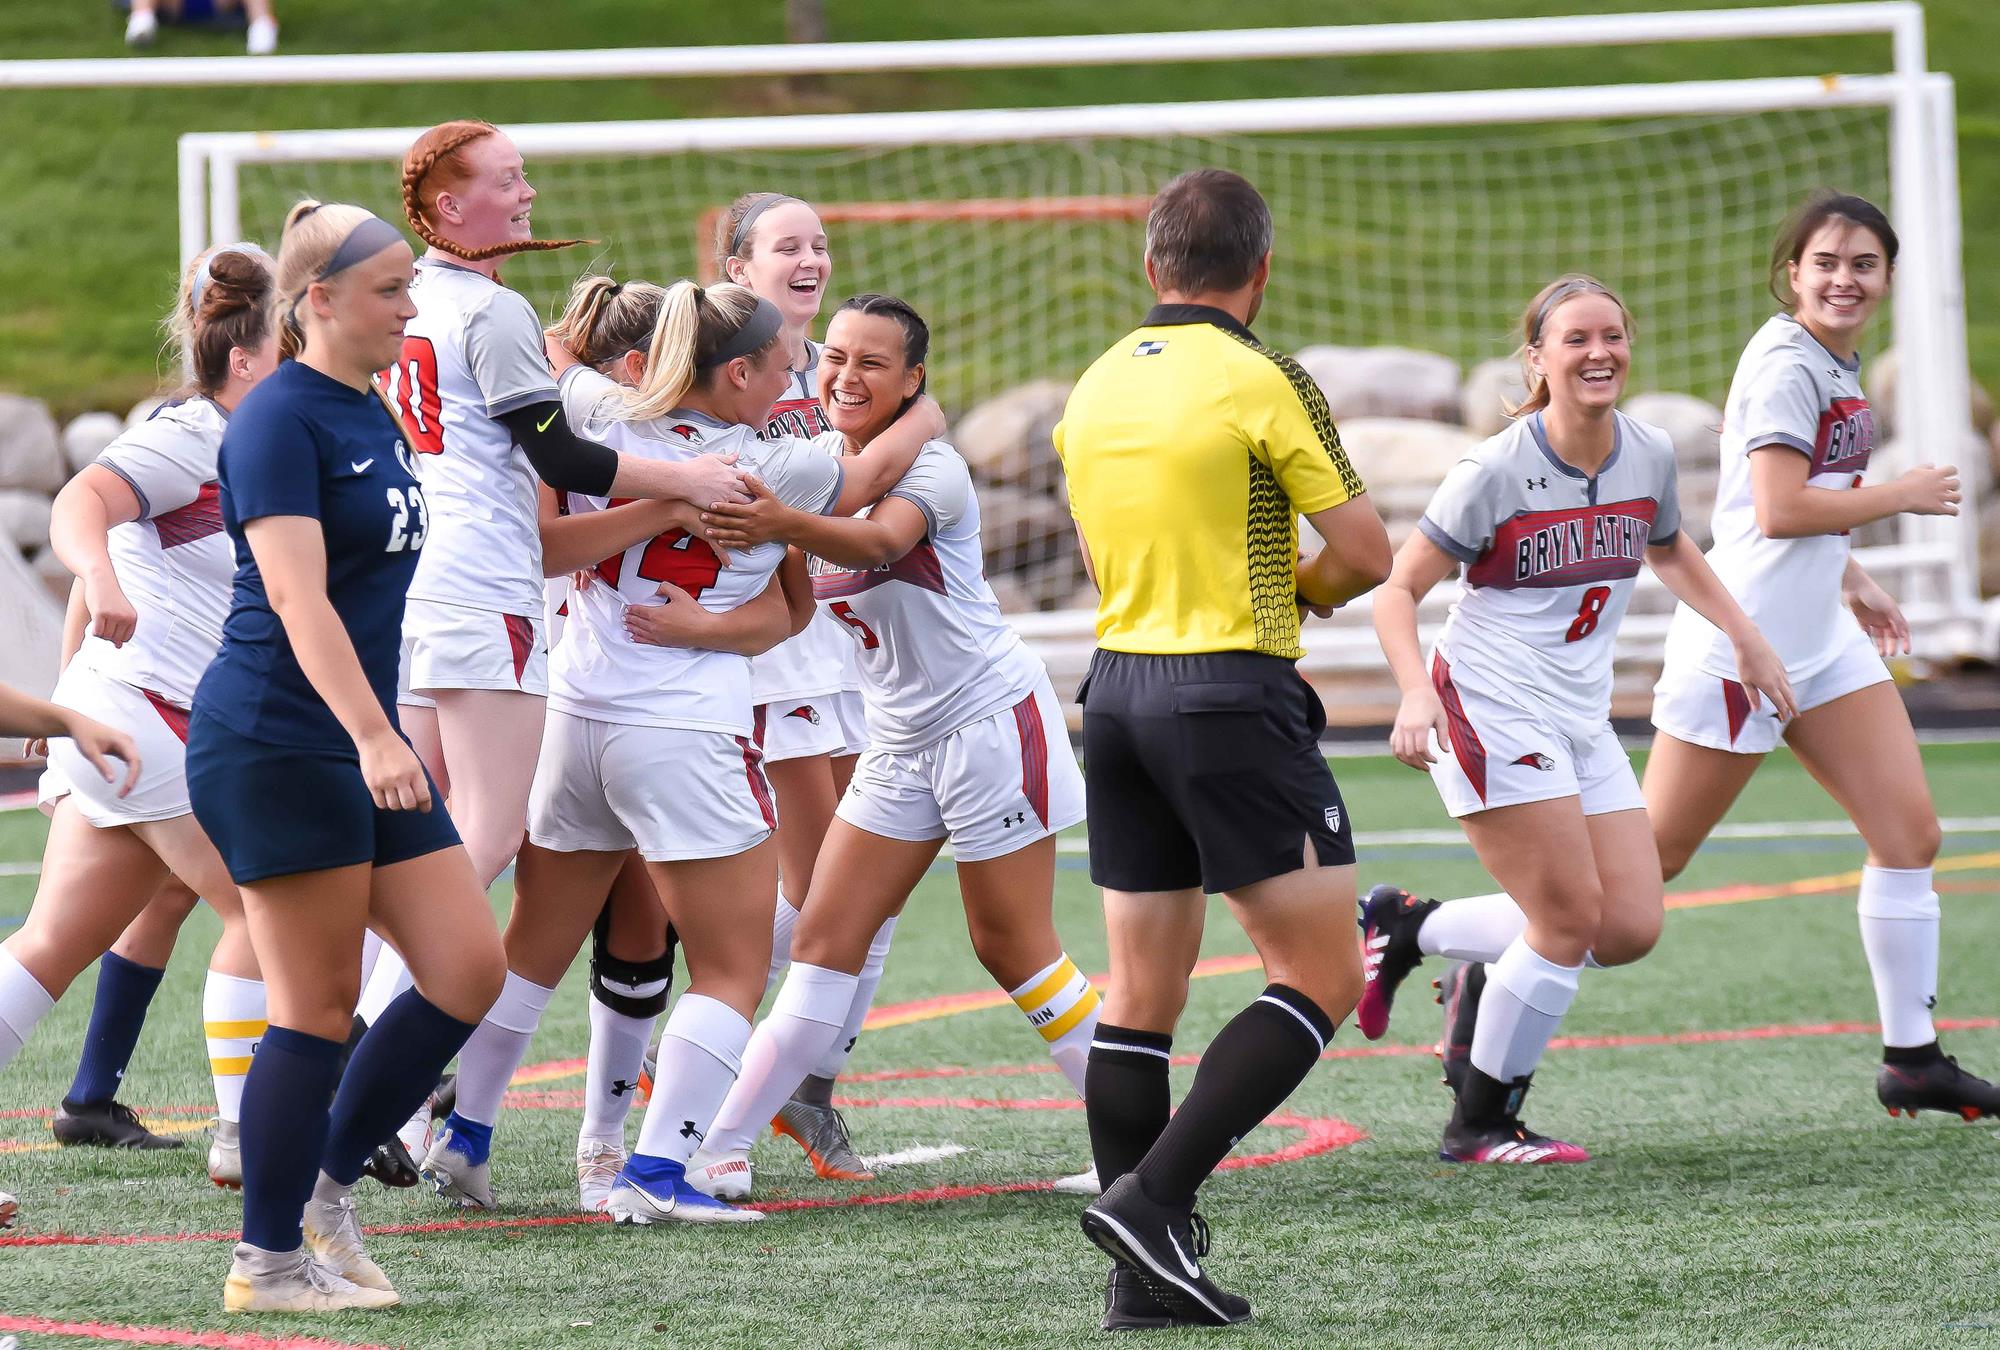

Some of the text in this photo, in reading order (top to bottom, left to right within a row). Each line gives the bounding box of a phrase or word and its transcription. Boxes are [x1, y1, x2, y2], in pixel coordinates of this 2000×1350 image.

[373, 335, 444, 455] 0
[385, 485, 429, 552] 23
[1515, 518, 1584, 581] BRYN
[828, 601, 880, 650] 5
[1565, 586, 1612, 643] 8
[704, 1160, 749, 1180] PUMA
